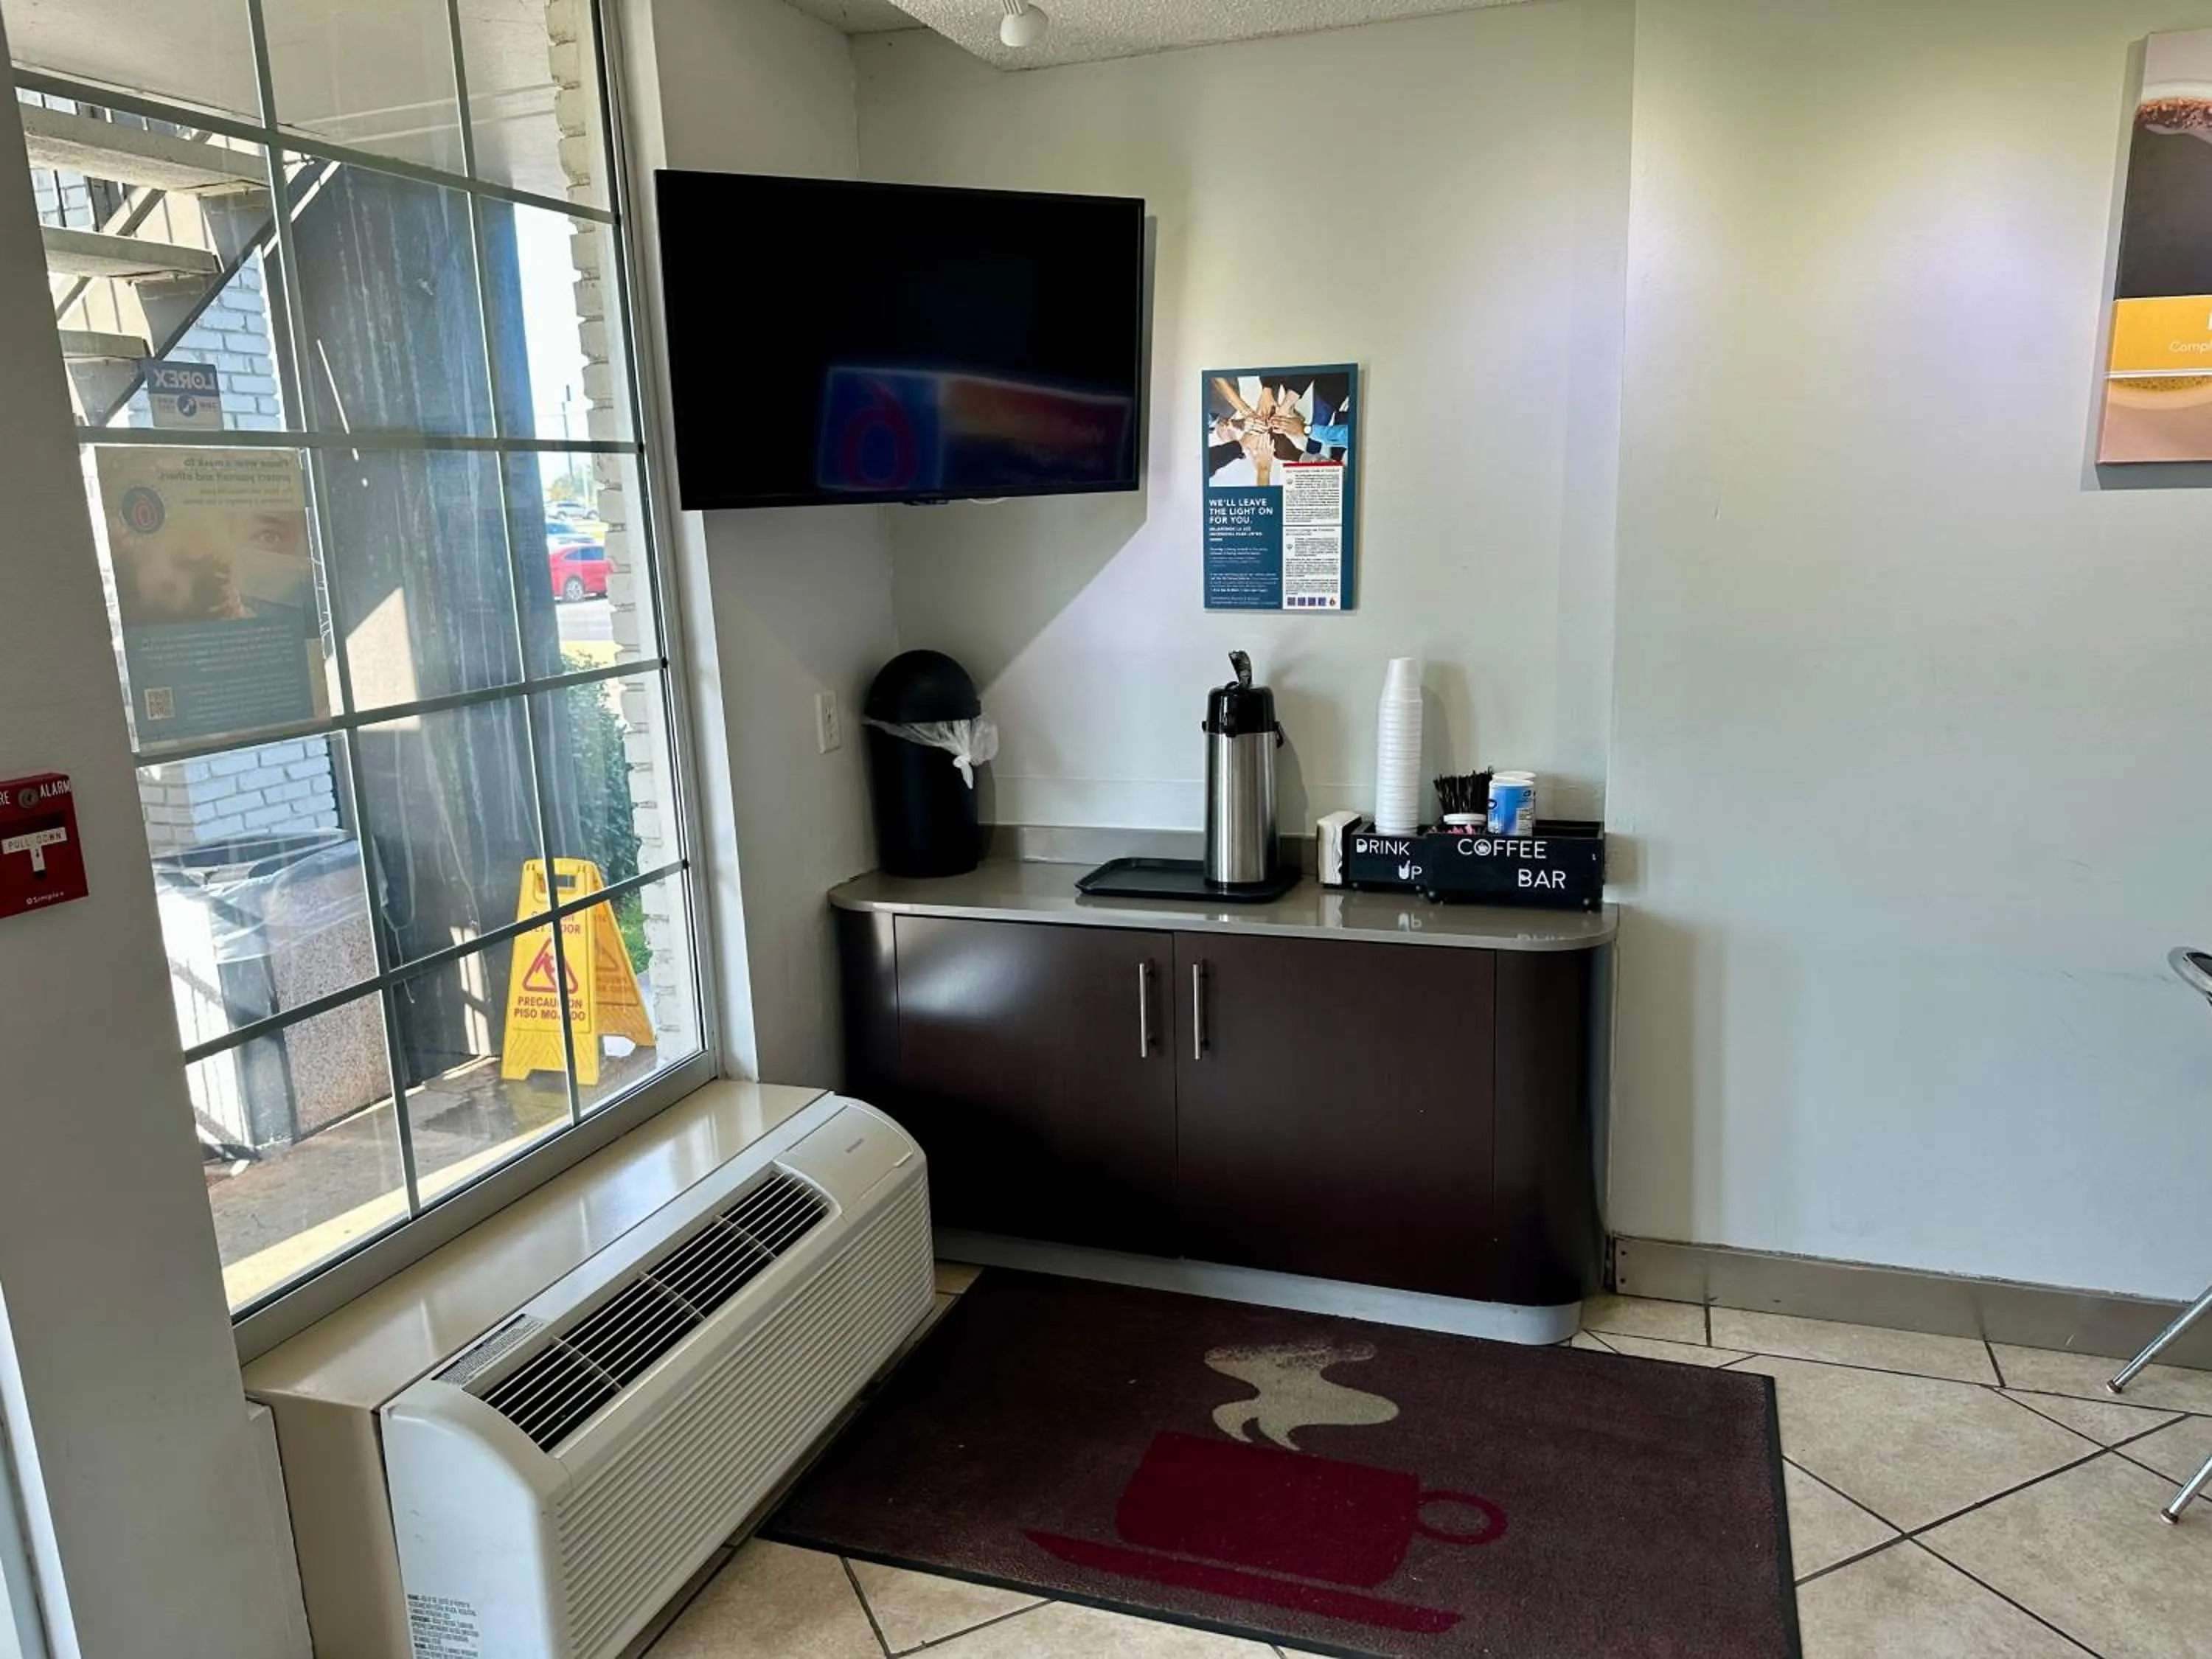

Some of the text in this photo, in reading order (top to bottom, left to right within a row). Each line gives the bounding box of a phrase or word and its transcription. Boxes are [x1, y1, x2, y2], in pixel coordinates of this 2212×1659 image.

[1208, 498, 1267, 507] WE'LL LEAVE
[1209, 507, 1273, 515] THE LIGHT ON
[1209, 516, 1253, 524] FOR YOU.
[40, 779, 72, 798] ALARM
[8, 832, 62, 851] PULL DOWN
[1356, 838, 1410, 856] DRINK
[1458, 838, 1548, 859] COFFEE
[1399, 860, 1422, 880] UP
[1517, 869, 1566, 889] BAR
[518, 995, 583, 1009] PRECAUON
[514, 1007, 586, 1021] PISO MODO
